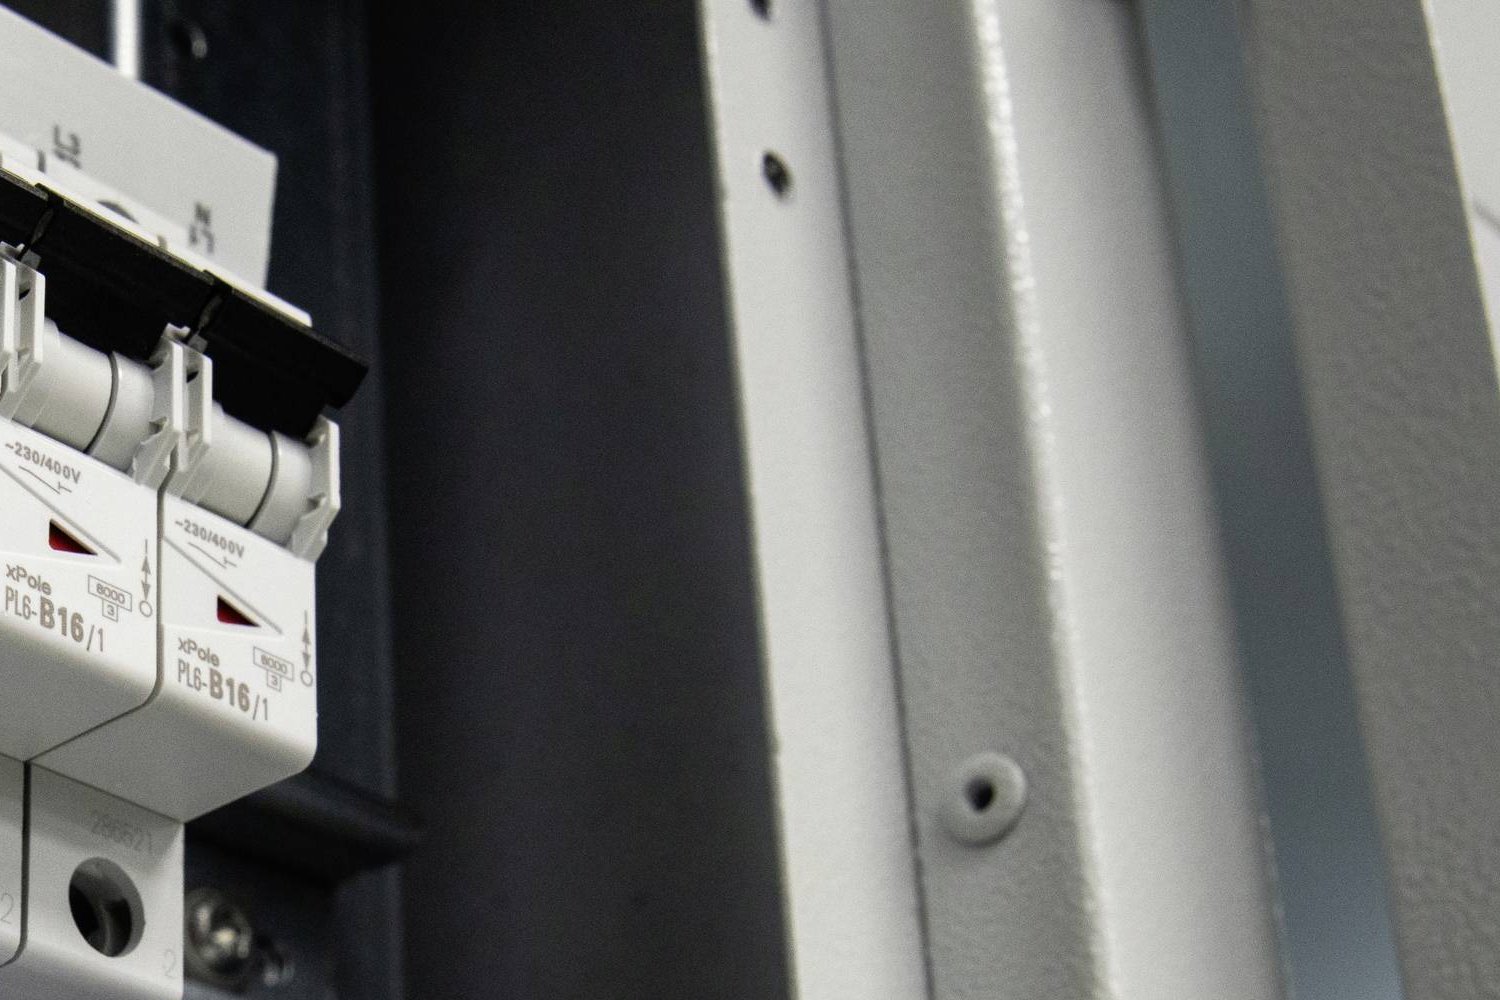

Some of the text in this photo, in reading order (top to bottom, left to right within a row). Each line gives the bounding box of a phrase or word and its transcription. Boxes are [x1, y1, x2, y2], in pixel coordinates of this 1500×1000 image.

[4, 441, 82, 485] ~230/400V
[6, 563, 52, 596] xPole
[106, 604, 116, 617] 3
[178, 637, 220, 668] xPole
[0, 892, 14, 924] 2
